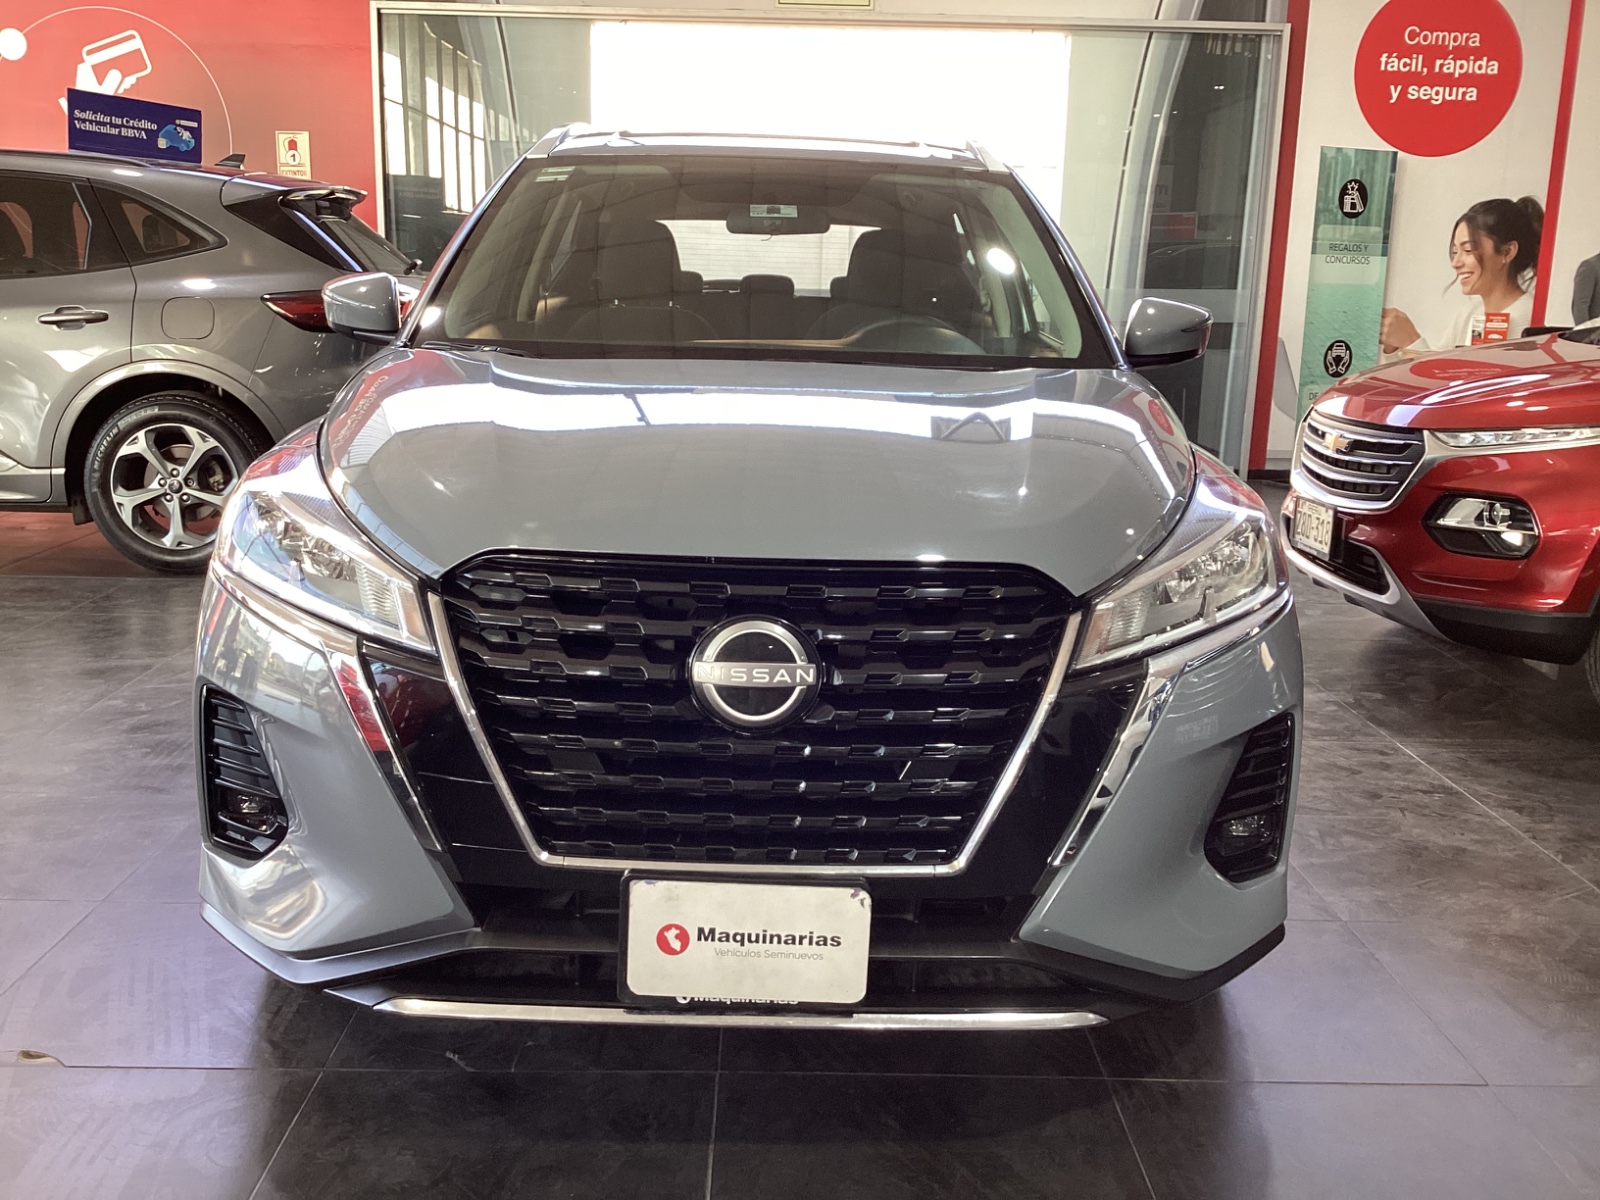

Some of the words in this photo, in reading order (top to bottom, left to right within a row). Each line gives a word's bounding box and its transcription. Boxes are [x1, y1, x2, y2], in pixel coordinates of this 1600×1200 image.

[1404, 26, 1481, 50] Compra
[1379, 53, 1428, 76] fácil,
[1434, 55, 1499, 78] rápida
[1389, 84, 1402, 103] y
[1407, 85, 1478, 105] segura
[73, 109, 111, 122] Solicita
[112, 116, 122, 125] tu
[123, 117, 158, 131] Crédito
[74, 120, 120, 135] Vehicular
[121, 127, 147, 139] BBVA
[290, 153, 297, 163] 1
[1329, 242, 1363, 253] REGALOS
[1364, 244, 1370, 253] Y
[1325, 254, 1371, 266] CONCURSOS
[93, 425, 119, 471] MICHELIN
[697, 664, 814, 684] NISSAN
[696, 926, 842, 948] Maquinarias
[763, 950, 824, 961] Seminuevos
